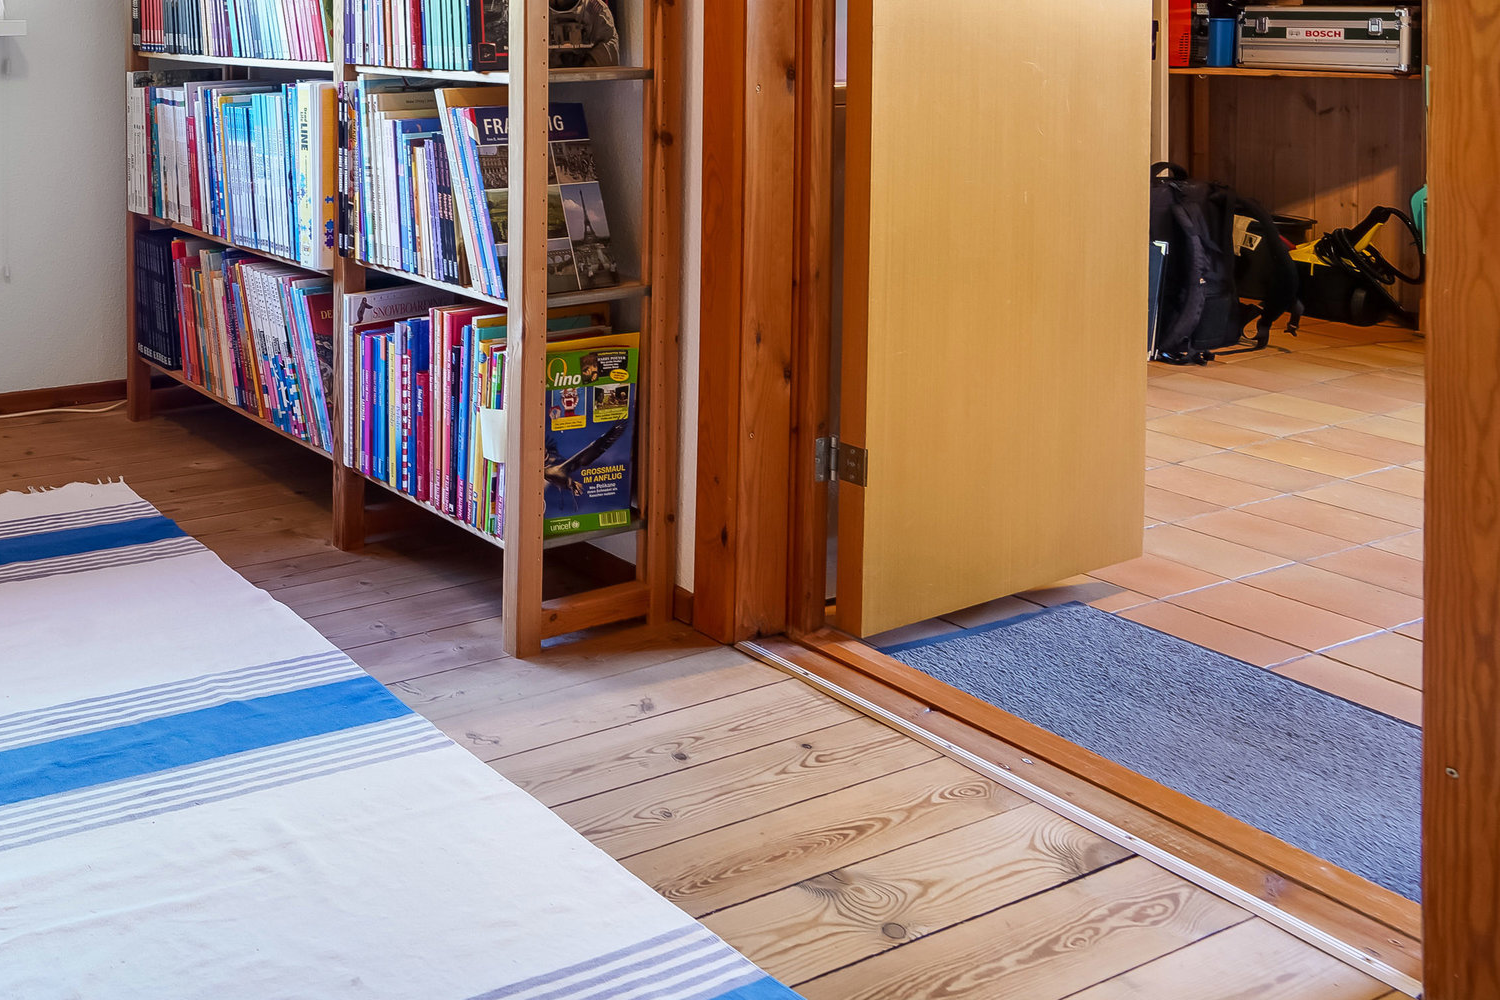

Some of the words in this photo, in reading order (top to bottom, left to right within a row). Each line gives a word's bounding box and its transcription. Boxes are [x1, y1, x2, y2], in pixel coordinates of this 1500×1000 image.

[300, 123, 308, 151] LINE
[581, 464, 626, 477] GROSSMAUL
[594, 472, 622, 482] ANFLUG
[550, 522, 571, 532] unicef
